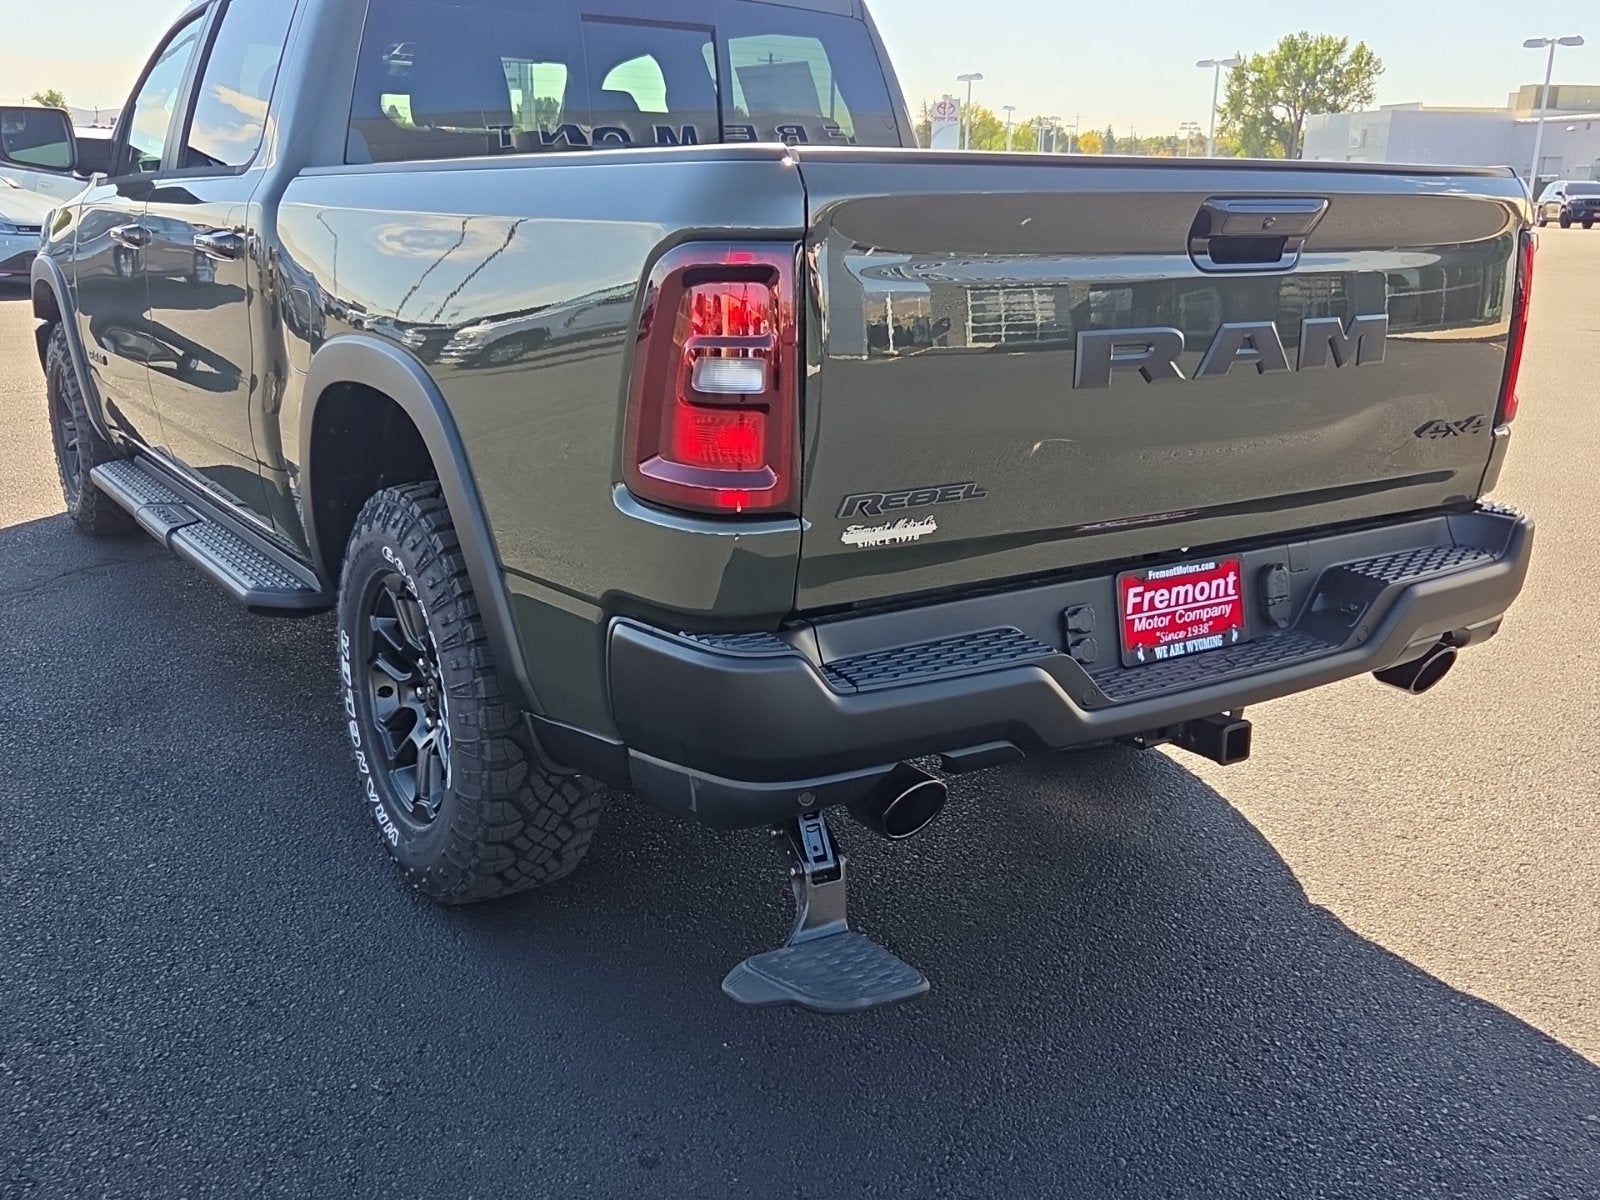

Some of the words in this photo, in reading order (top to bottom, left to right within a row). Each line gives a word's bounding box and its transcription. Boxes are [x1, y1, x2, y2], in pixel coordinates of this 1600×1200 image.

[1073, 313, 1389, 389] RAM
[836, 481, 988, 519] REBEL
[857, 538, 890, 548] SINCE
[1148, 562, 1215, 580] FremontMotors.com
[1126, 571, 1237, 615] Fremont
[1134, 614, 1171, 632] Motor
[1175, 603, 1233, 625] Company
[1154, 645, 1168, 659] WE
[1169, 642, 1185, 657] ARE
[1186, 635, 1223, 653] WYOMING
[340, 629, 400, 847] WRANGLER
